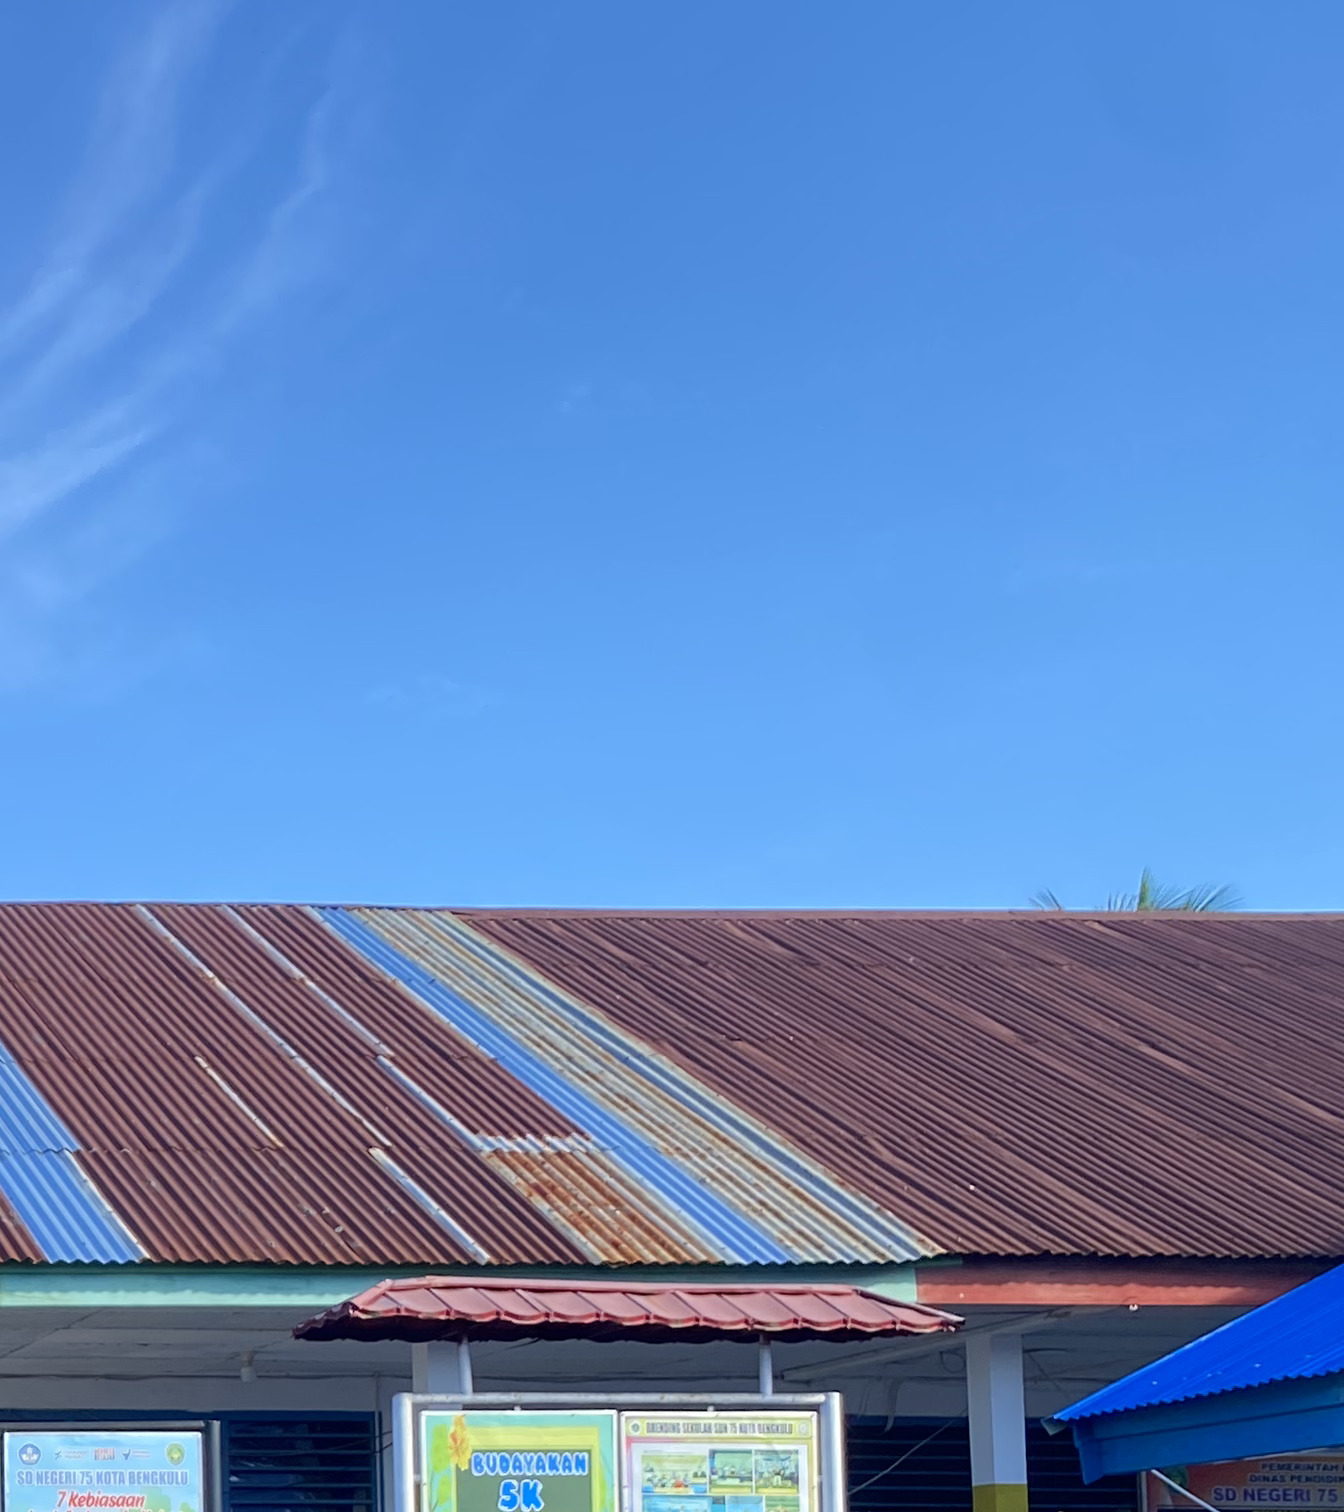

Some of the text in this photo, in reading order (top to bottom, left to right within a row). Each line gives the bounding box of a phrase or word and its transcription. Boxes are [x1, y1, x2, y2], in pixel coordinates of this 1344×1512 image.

[472, 1452, 588, 1475] BUDAYAKAN
[17, 1471, 188, 1485] SD NEGERI 75 KOTA BENGKULU
[1249, 1474, 1286, 1483] DINAS
[57, 1490, 145, 1507] 7 Kebiasaan
[498, 1480, 544, 1512] 5K
[1213, 1487, 1339, 1502] SD NEGERI 75
